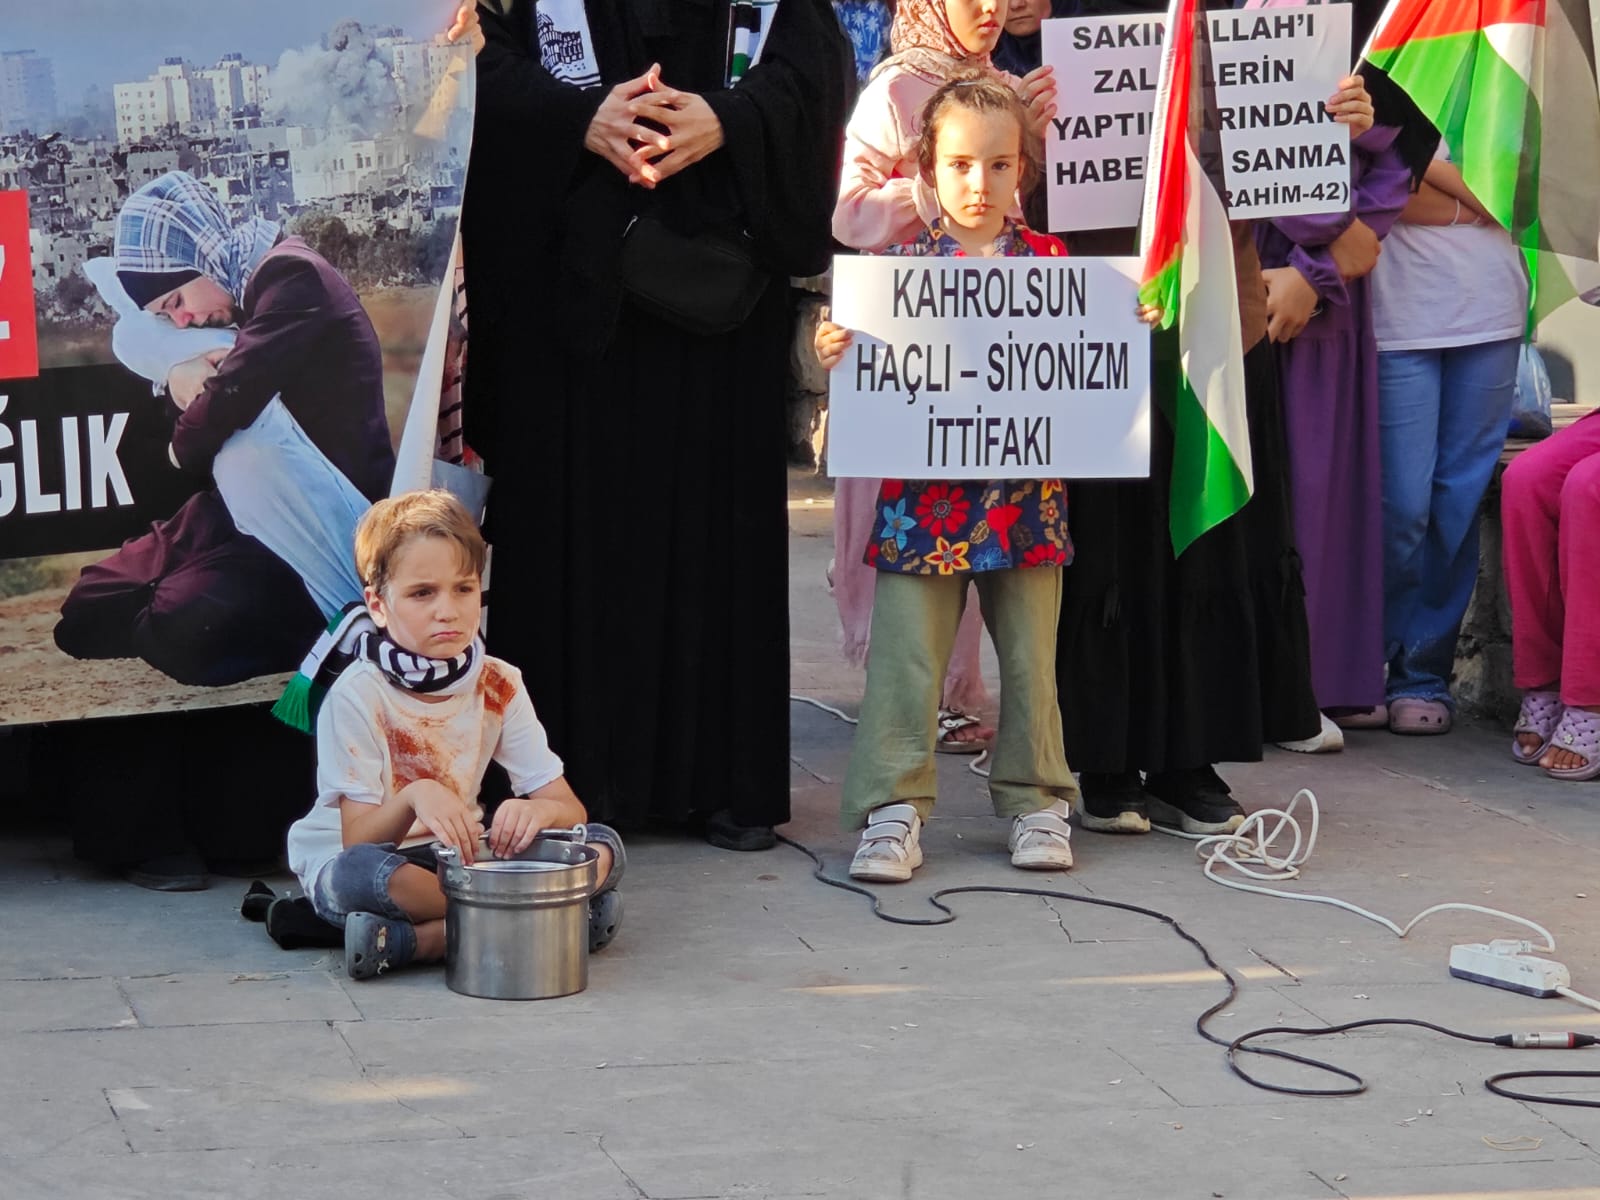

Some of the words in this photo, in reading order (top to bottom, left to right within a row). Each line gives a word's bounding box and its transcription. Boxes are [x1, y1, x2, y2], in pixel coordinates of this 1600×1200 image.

[1232, 143, 1346, 173] SANMA
[1221, 181, 1348, 208] RAHİM-42)
[893, 267, 1086, 318] KAHROLSUN
[856, 343, 951, 405] HAÇLI
[987, 330, 1129, 392] SİYONİZM
[927, 404, 1052, 467] İTTİFAKI
